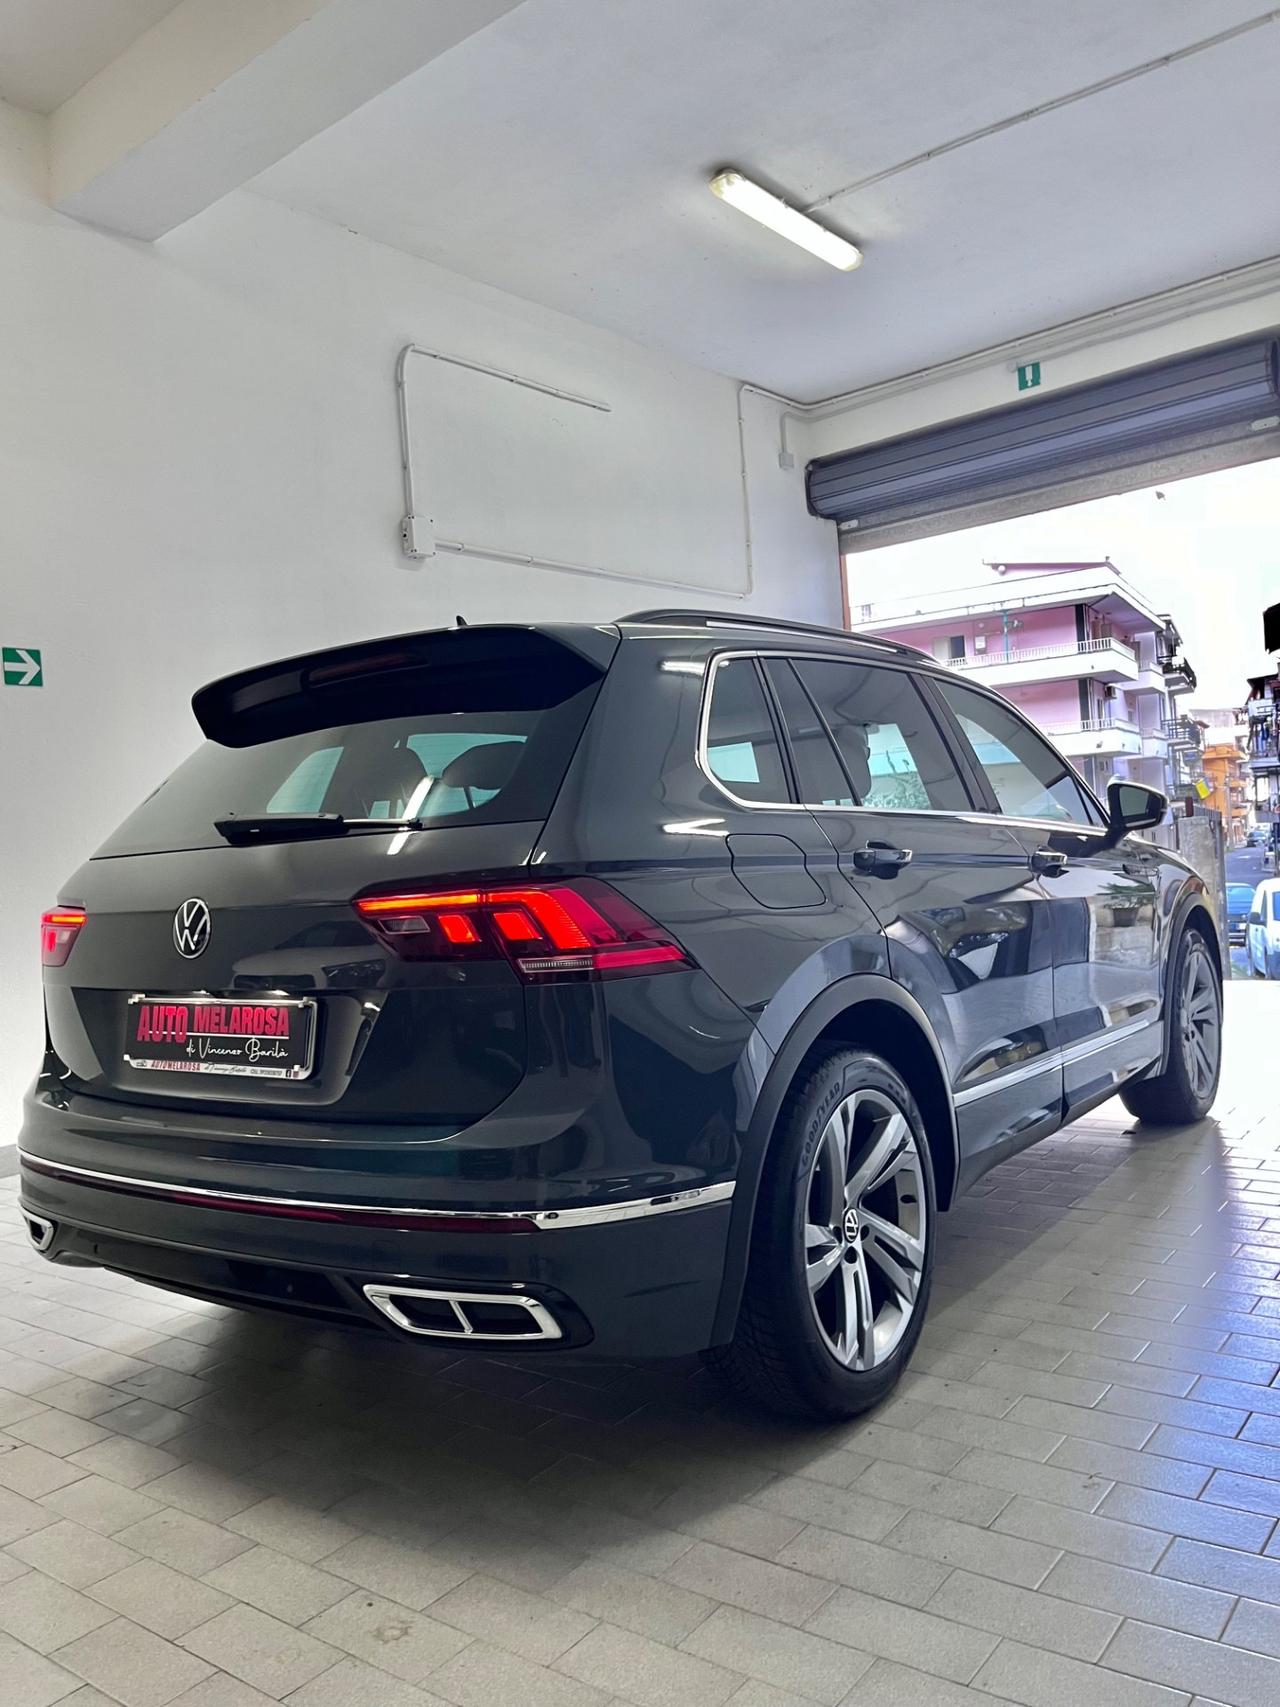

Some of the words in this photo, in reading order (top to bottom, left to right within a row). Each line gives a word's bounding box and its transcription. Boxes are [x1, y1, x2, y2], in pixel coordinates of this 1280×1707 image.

[137, 1005, 189, 1043] AUTO
[193, 1005, 289, 1036] MELAROSA
[186, 1039, 195, 1057] di
[199, 1038, 243, 1060] Vincenzo
[245, 1037, 289, 1062] Barilà
[150, 1060, 201, 1071] AUTOMELAROSA
[801, 1082, 841, 1167] GOODYEAR
